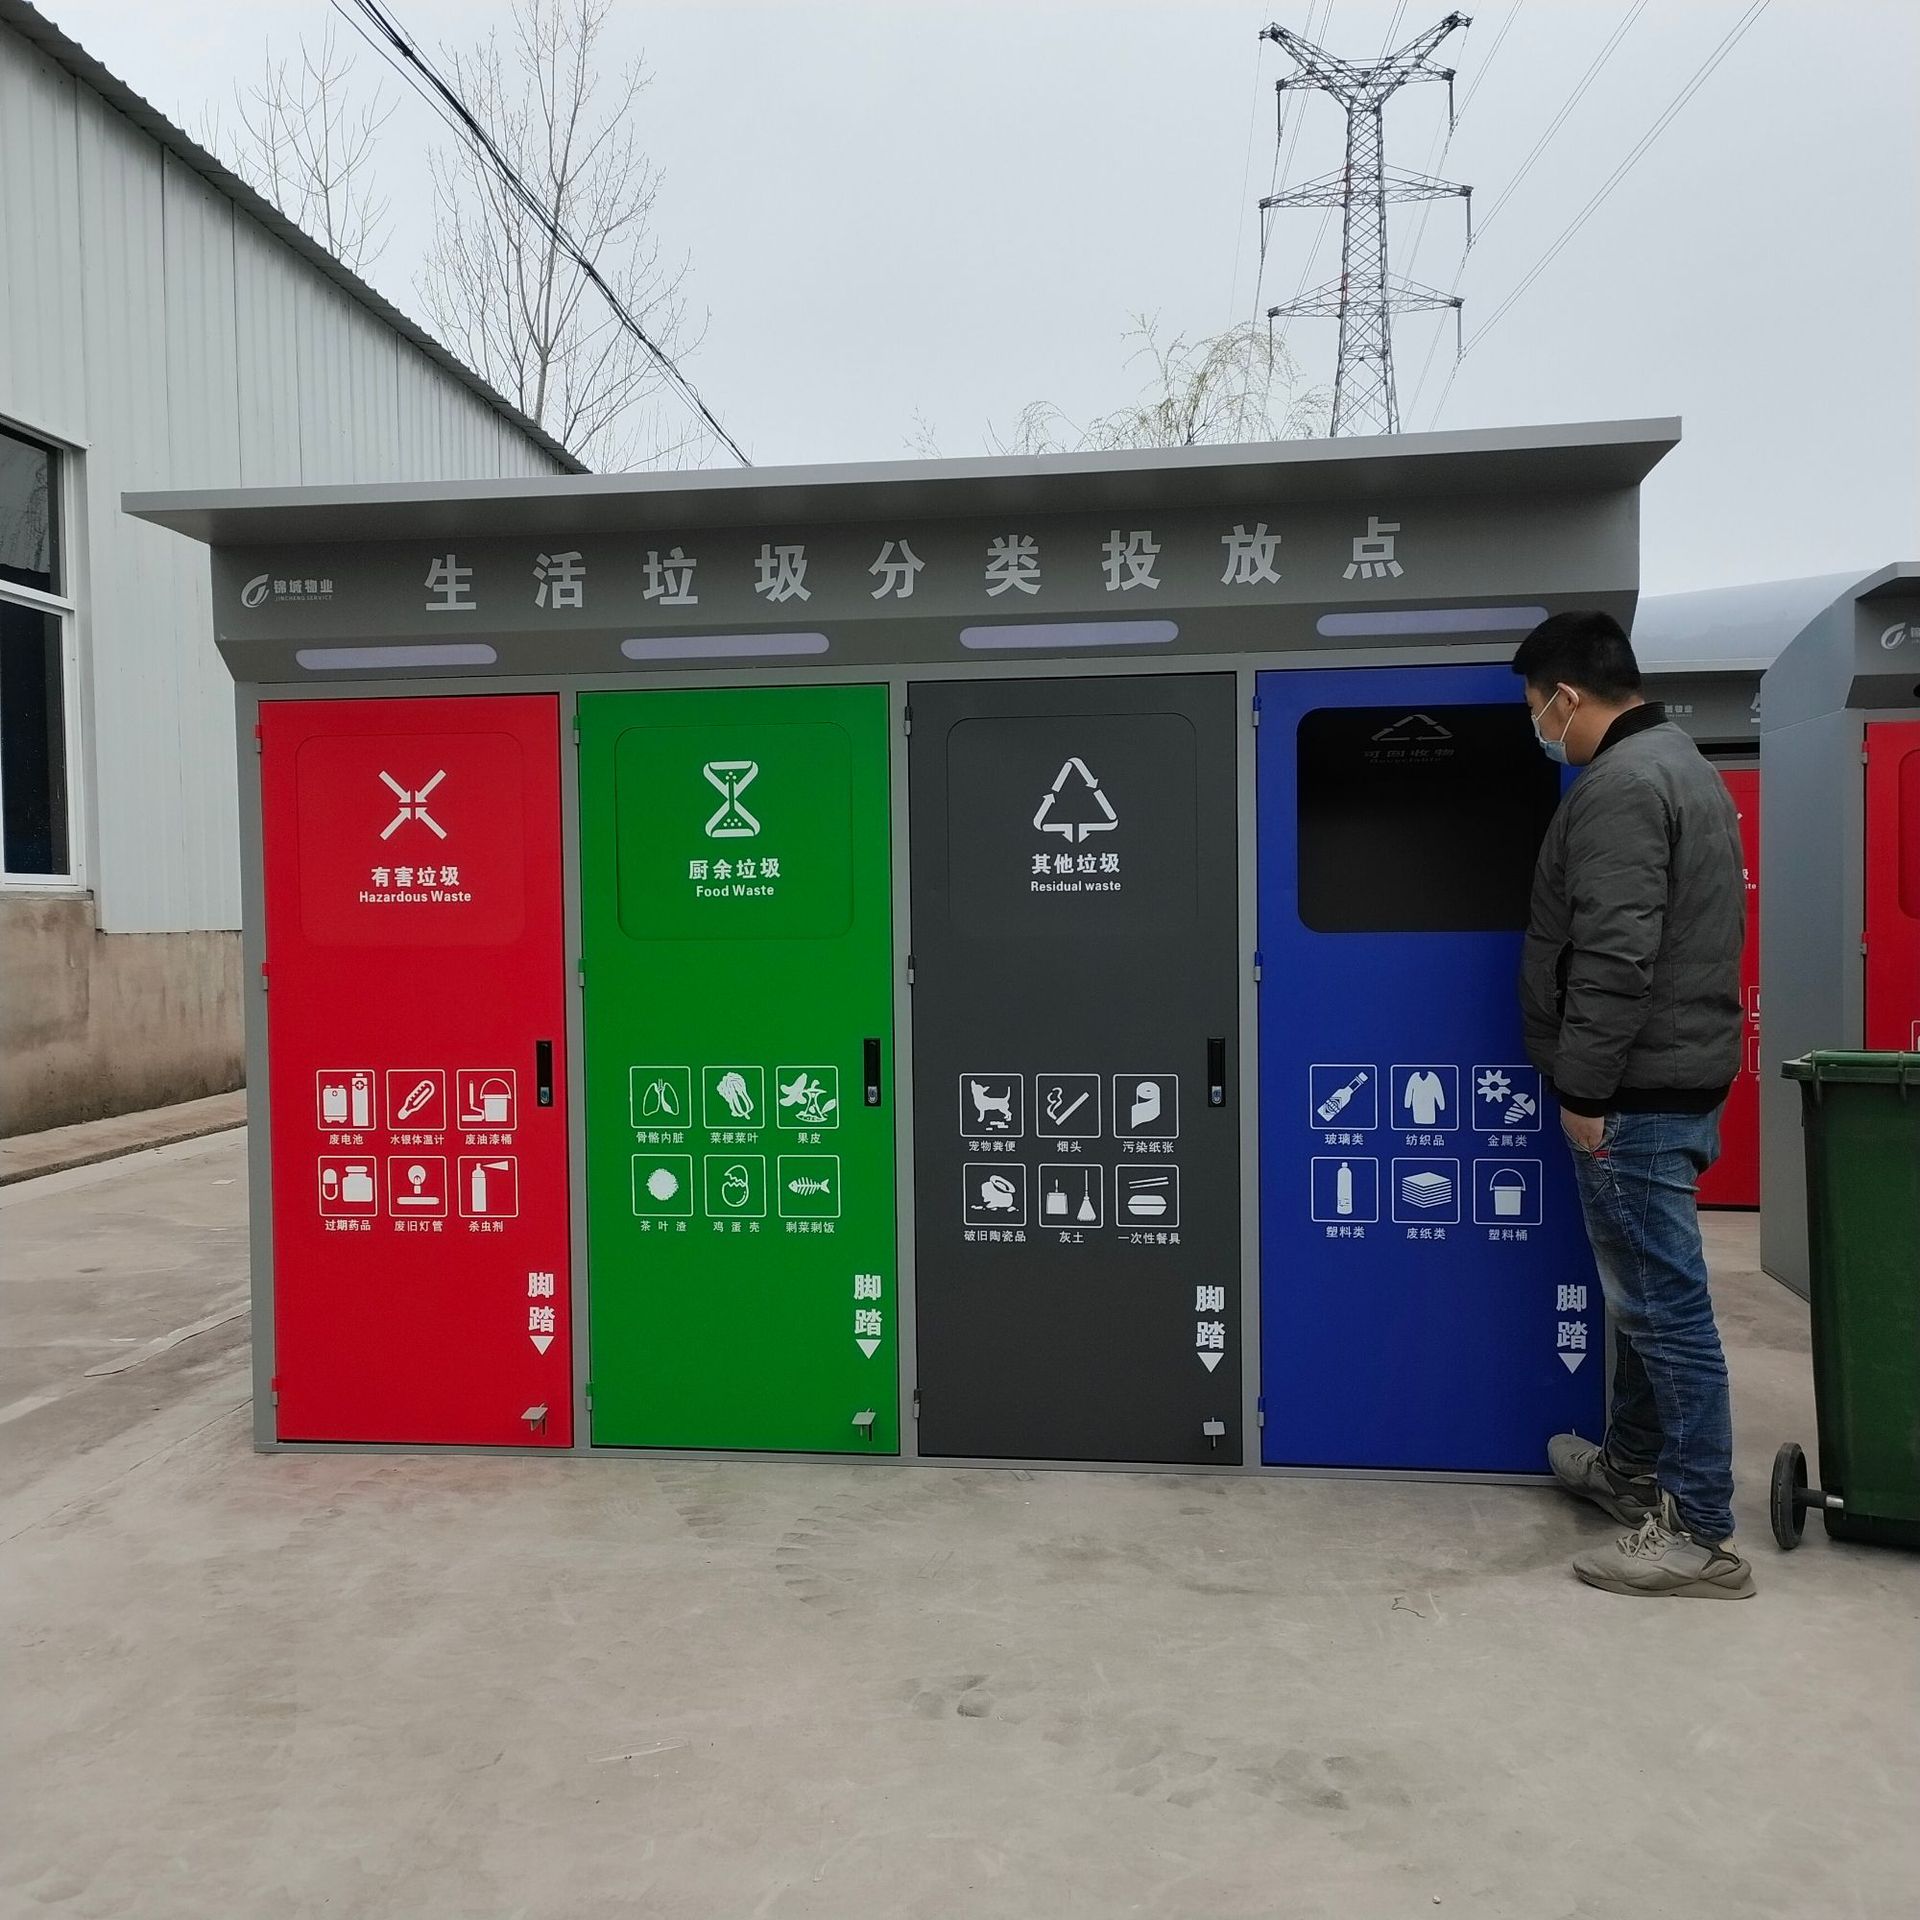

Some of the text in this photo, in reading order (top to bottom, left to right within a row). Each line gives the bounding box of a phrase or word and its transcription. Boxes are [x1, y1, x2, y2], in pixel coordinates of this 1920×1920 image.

[424, 516, 1404, 611] 生活垃圾分类投放点
[689, 858, 781, 880] 厨余垃圾
[1031, 853, 1120, 875] 其他垃圾
[371, 865, 460, 887] 有害垃圾
[696, 884, 775, 897] Food Waste
[1030, 880, 1121, 892] Residual waste
[359, 890, 471, 902] Hazardous Waste
[329, 1134, 364, 1145] 废电池
[390, 1134, 445, 1145] 水银体温计
[465, 1134, 513, 1145] 废油漆桶
[636, 1132, 684, 1144] 骨骼内脏
[710, 1132, 759, 1144] 菜梗菜叶
[797, 1132, 821, 1144] 果皮
[1324, 1133, 1364, 1145] 玻璃类
[1406, 1134, 1445, 1147] 纺织品
[1487, 1135, 1528, 1147] 金属类
[968, 1141, 1016, 1152] 宠物粪便
[1057, 1140, 1082, 1153] 烟头
[1122, 1141, 1174, 1153] 污染纸张
[325, 1219, 371, 1231] 过期药品
[394, 1220, 443, 1232] 废旧灯管
[468, 1220, 504, 1233] 杀虫剂
[640, 1220, 687, 1232] 茶叶渣
[713, 1221, 760, 1233] 鸡蛋壳
[785, 1222, 835, 1234] 剩菜剩饭
[964, 1230, 1026, 1242] 破旧陶瓷品
[1059, 1231, 1084, 1243] 灰土
[1326, 1226, 1365, 1238] 塑料类
[1406, 1227, 1446, 1240] 废纸类
[1488, 1228, 1528, 1241] 塑料桶
[1117, 1232, 1181, 1245] 一次性餐具
[528, 1272, 555, 1332] 脚踏
[854, 1274, 883, 1336] 脚踏
[1195, 1285, 1226, 1349] 脚踏
[1556, 1284, 1588, 1350] 脚踏
